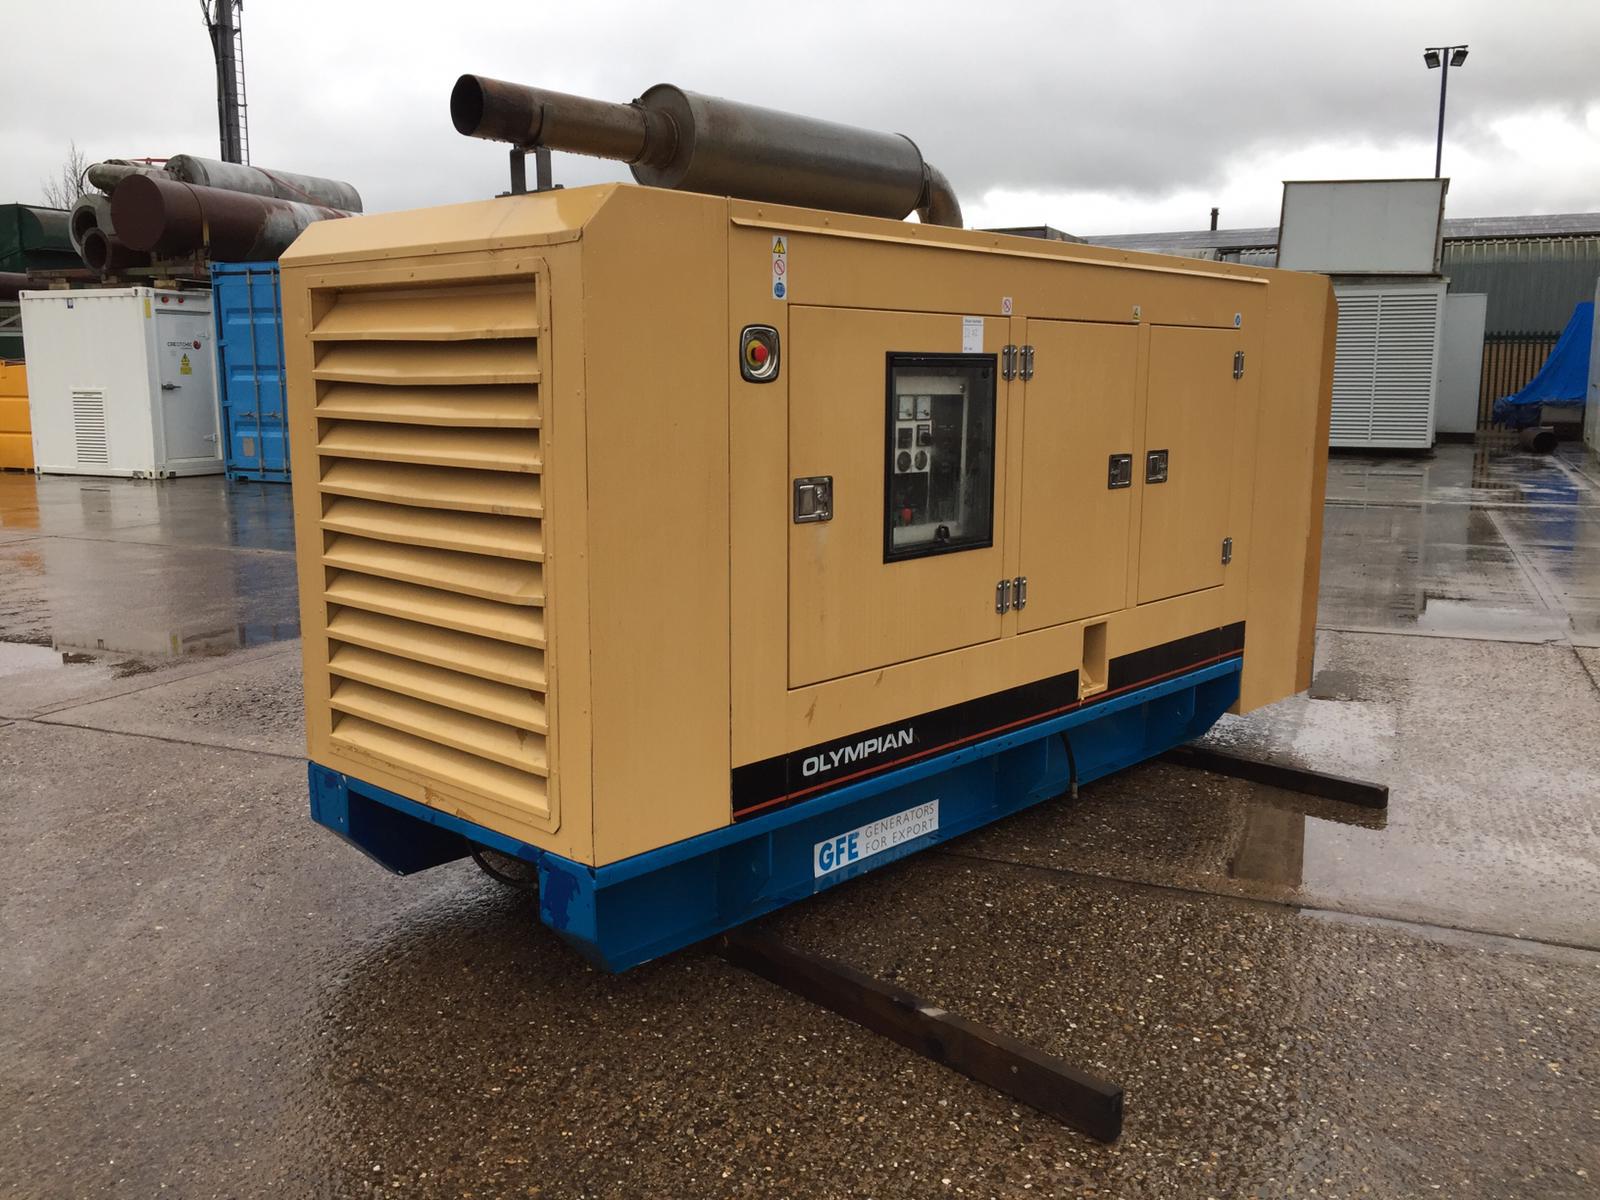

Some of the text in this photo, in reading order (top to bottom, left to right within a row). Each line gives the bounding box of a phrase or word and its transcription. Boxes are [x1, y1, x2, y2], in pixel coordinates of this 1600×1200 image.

[802, 727, 914, 777] OLYMPIAN
[865, 803, 934, 838] GENERATORS
[865, 818, 934, 854] FOR EXPORT
[818, 831, 860, 871] GFE
